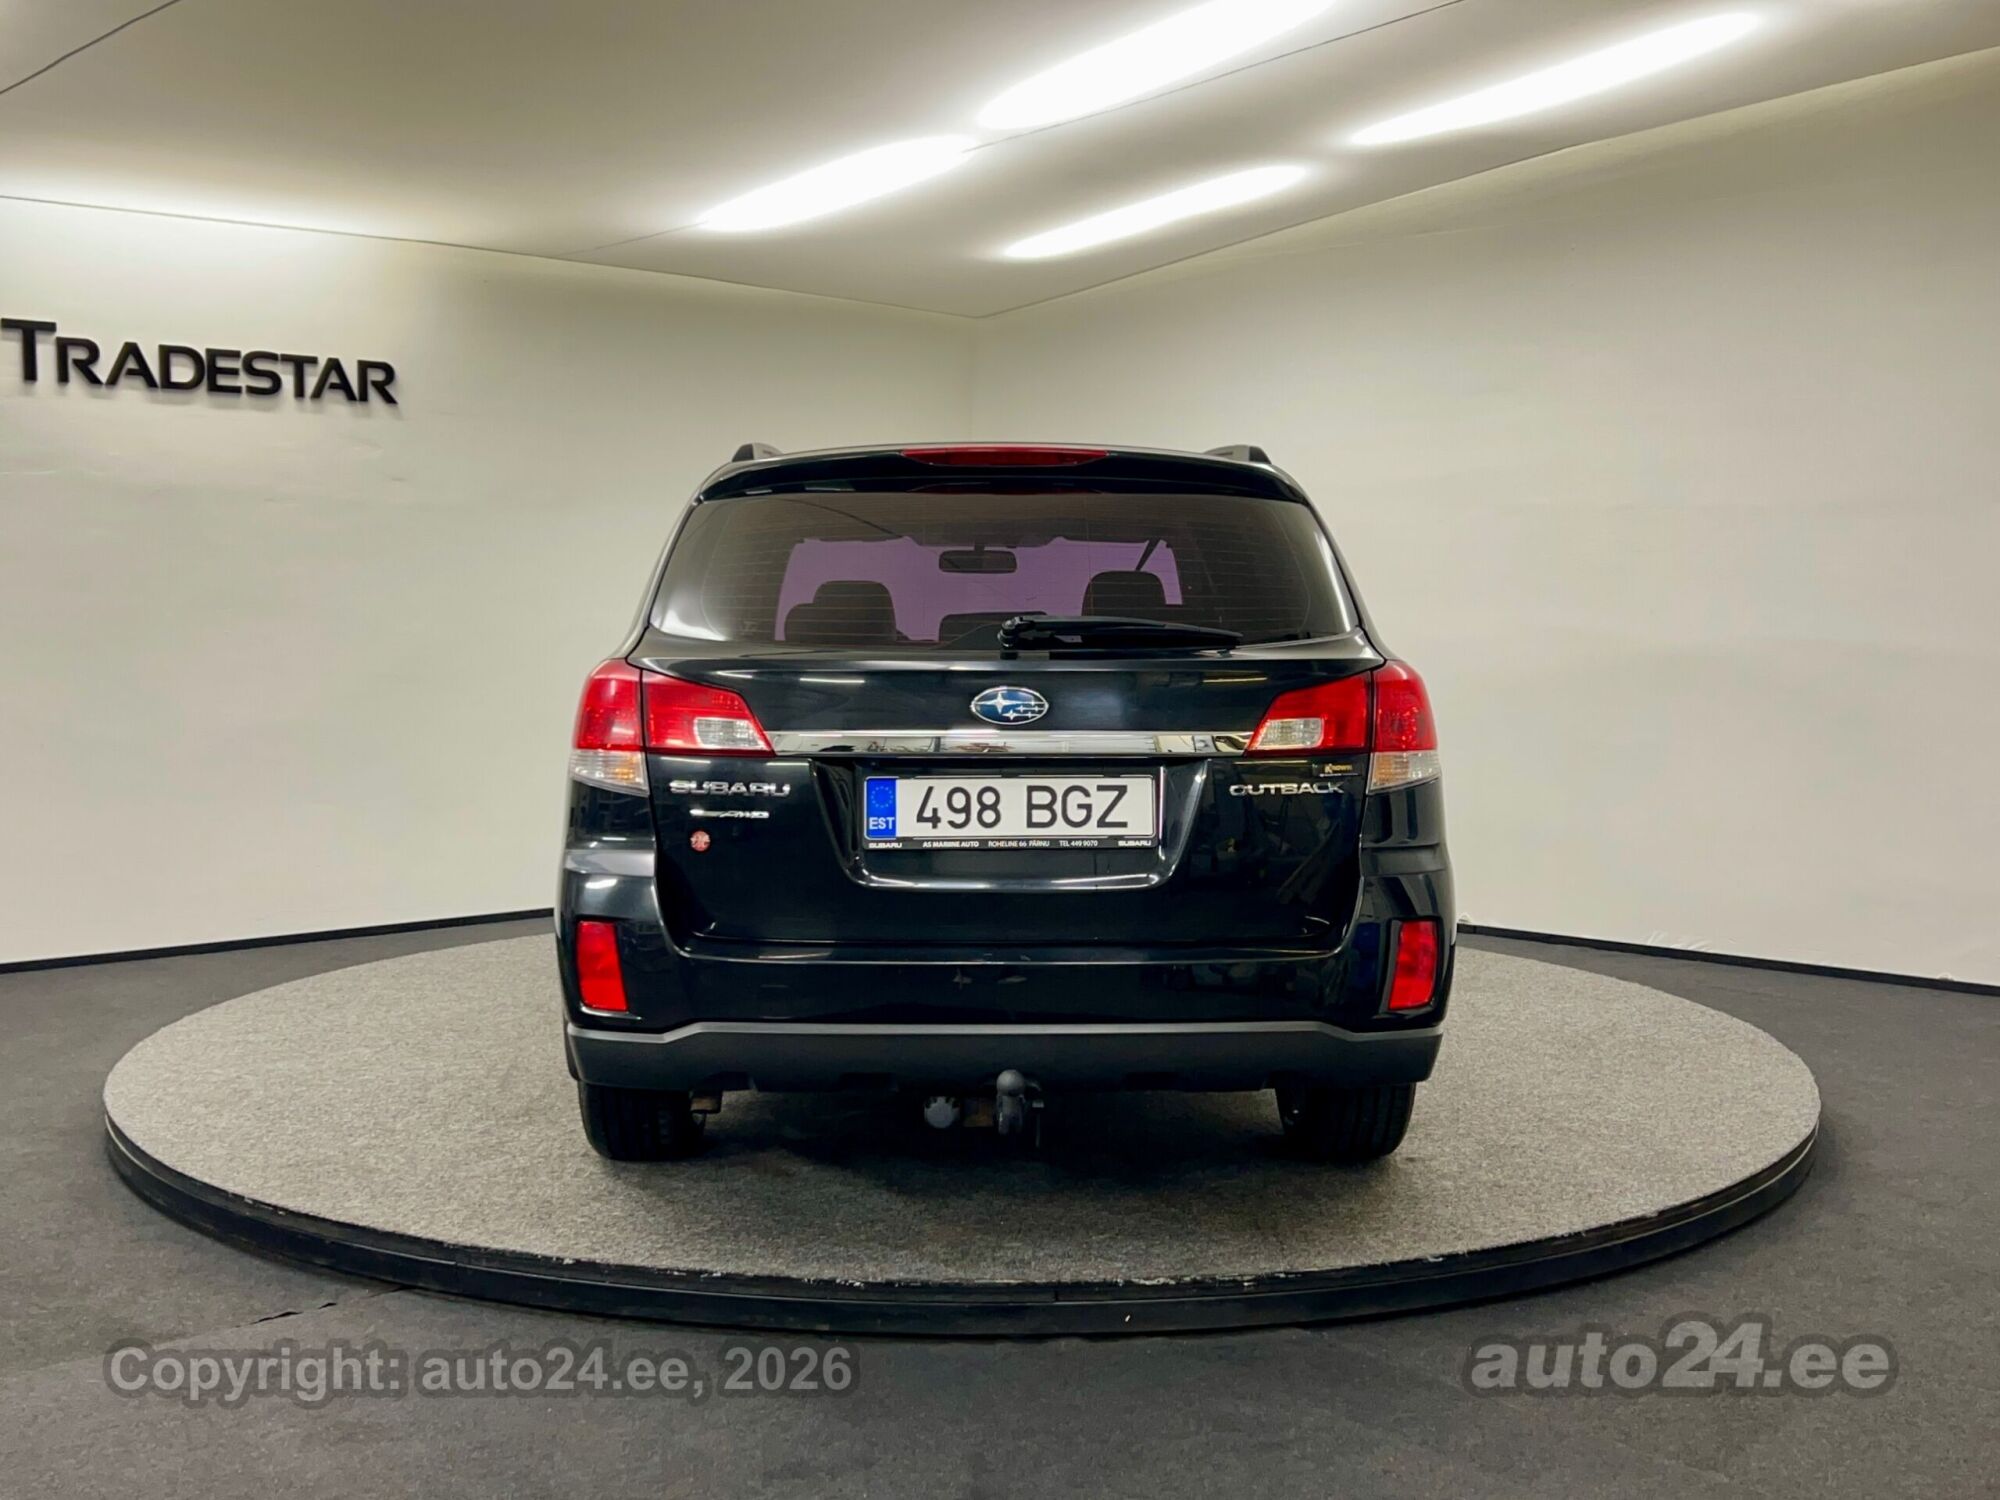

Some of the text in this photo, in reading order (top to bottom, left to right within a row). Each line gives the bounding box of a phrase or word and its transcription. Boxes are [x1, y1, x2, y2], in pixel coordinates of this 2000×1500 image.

[0, 317, 398, 404] TRADESTAR
[669, 779, 791, 797] SUBARU
[1229, 781, 1345, 797] OUTBACK
[916, 785, 1129, 829] 498 BGZ
[868, 817, 895, 830] EST
[961, 840, 980, 848] AUTO
